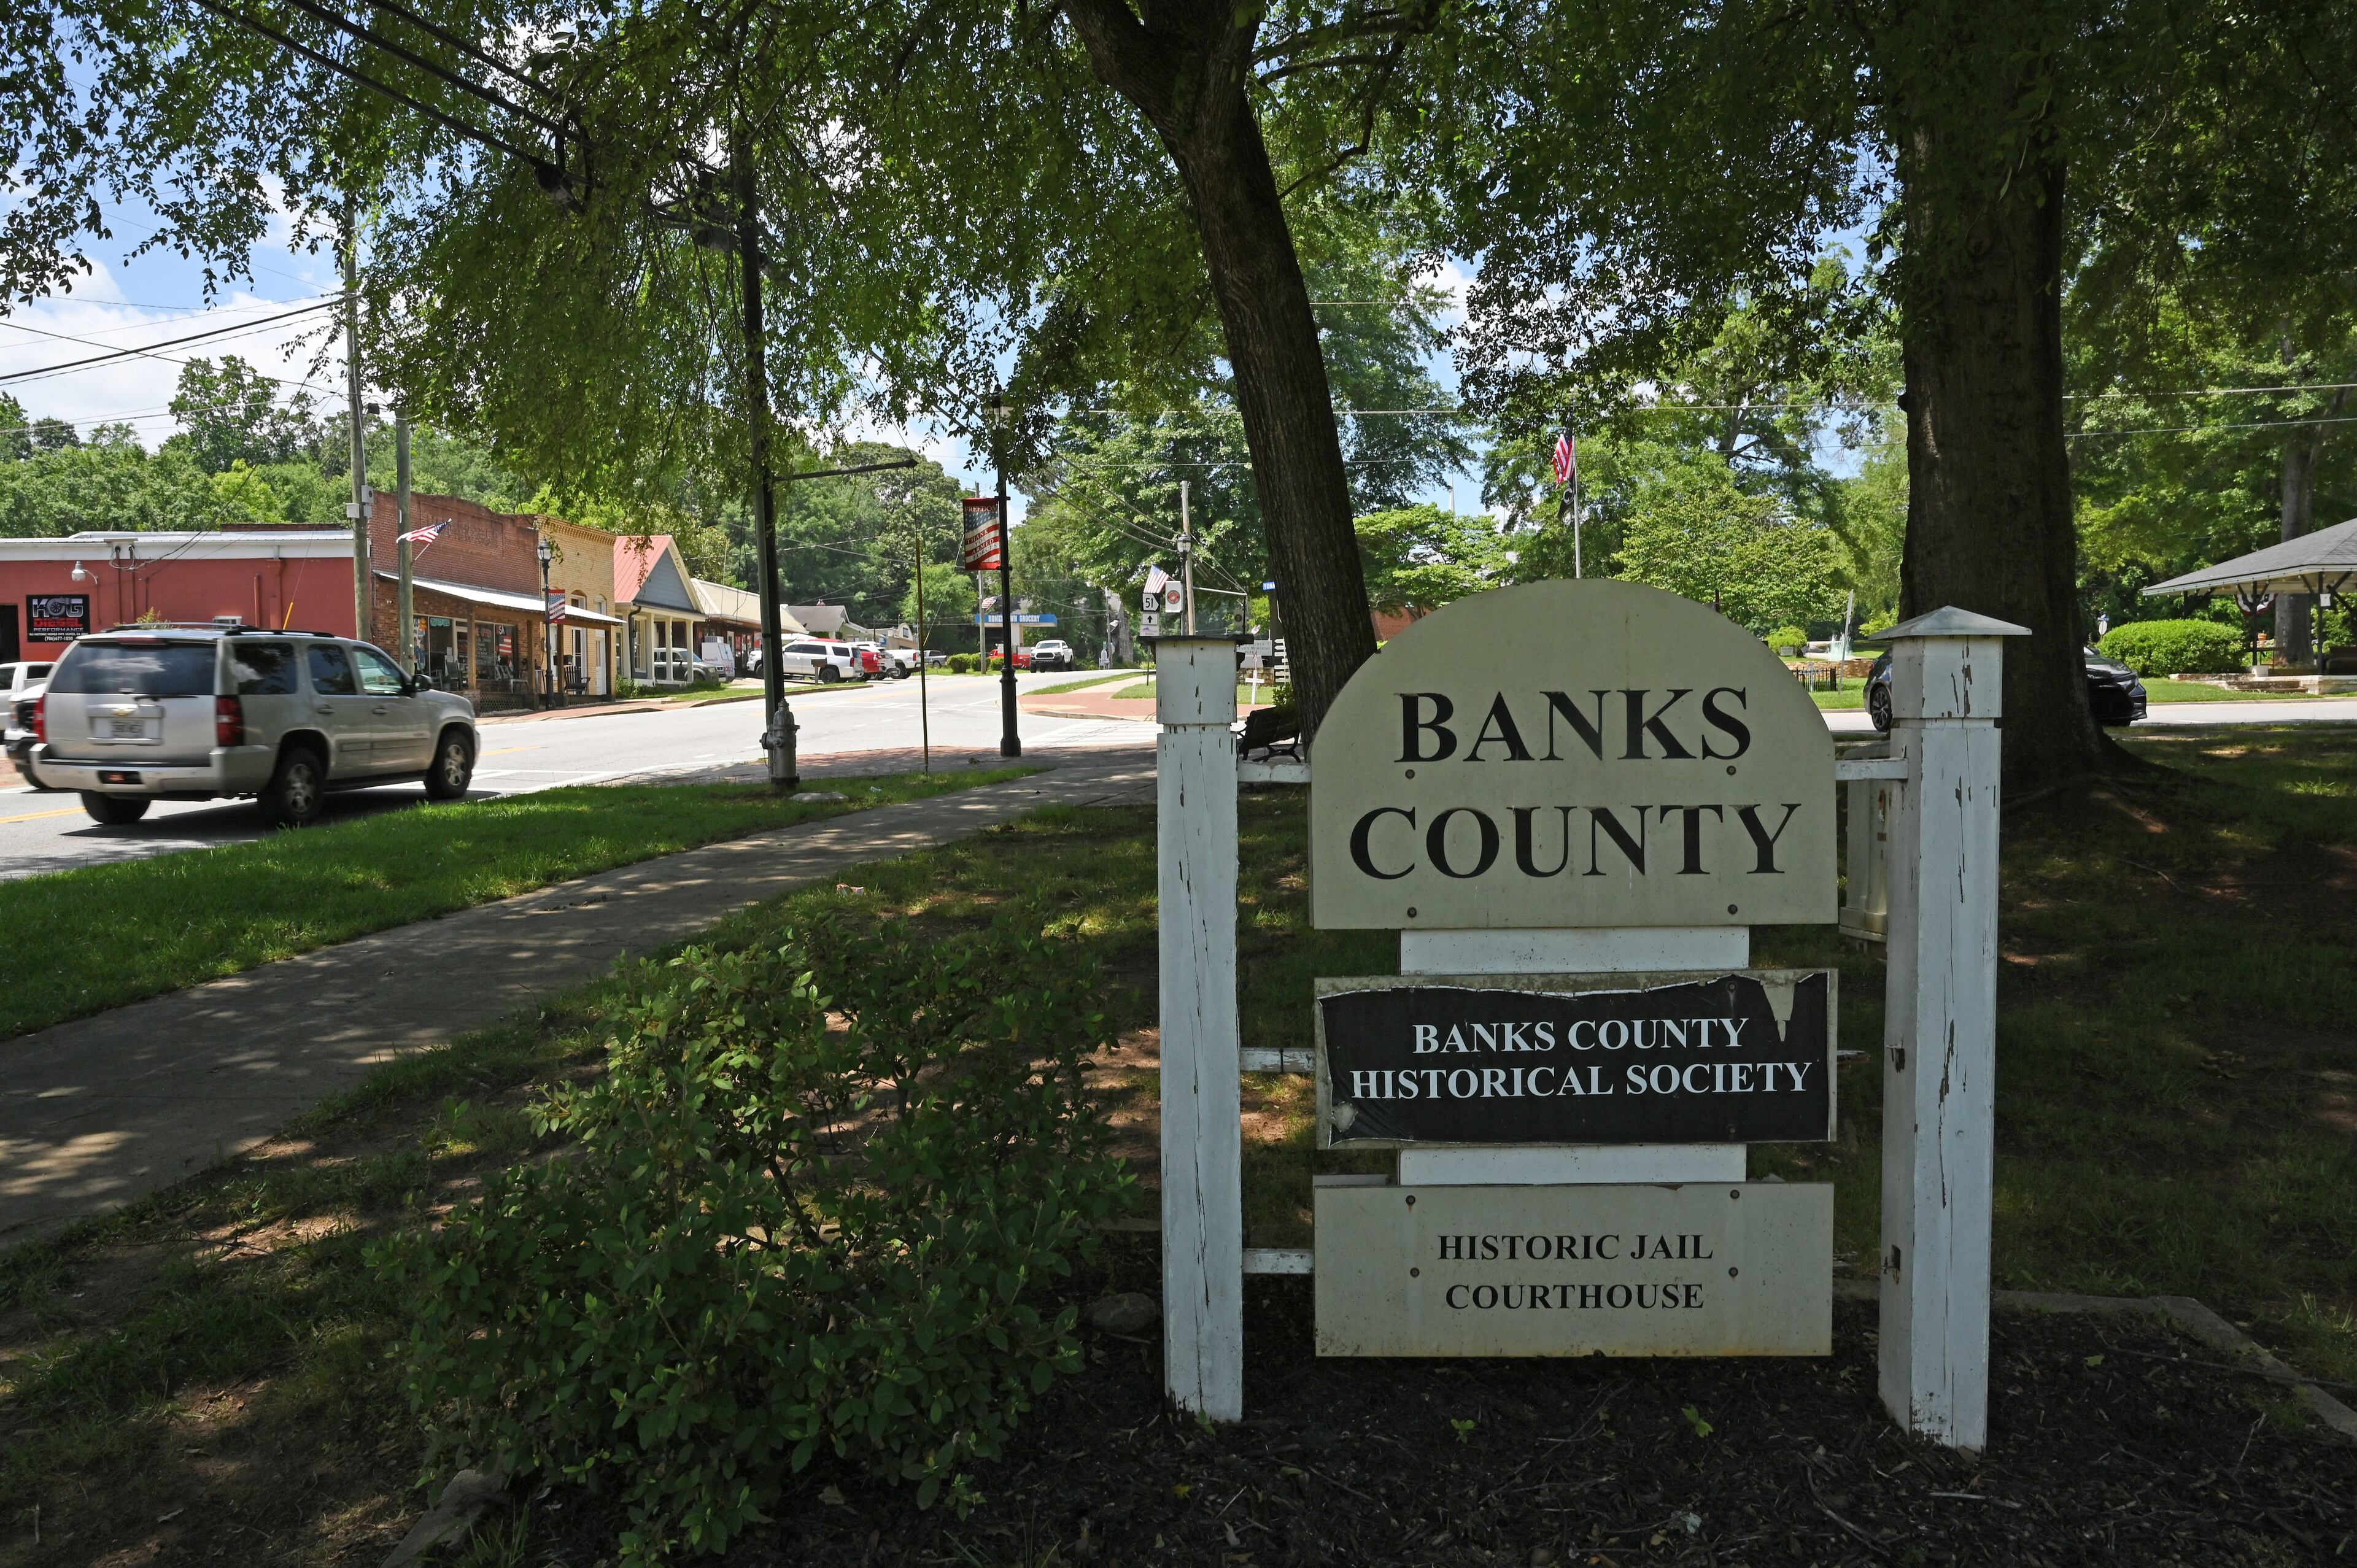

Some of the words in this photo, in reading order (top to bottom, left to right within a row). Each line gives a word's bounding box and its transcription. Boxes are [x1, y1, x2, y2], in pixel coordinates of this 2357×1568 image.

[967, 528, 989, 544] THANK
[972, 538, 994, 555] ARMED
[975, 535, 988, 546] YOU
[972, 544, 997, 560] FORCES
[1145, 598, 1153, 608] 51
[1394, 687, 1751, 763] BANKS
[1350, 803, 1802, 880] COUNTY
[1412, 1021, 1557, 1054] BANKS
[1568, 1017, 1749, 1052] COUNTY
[1350, 1065, 1614, 1100] HISTORICAL
[1626, 1061, 1813, 1096] SOCIETY
[1438, 1234, 1619, 1261] HISTORIC
[1630, 1233, 1714, 1260] JAIL
[1445, 1283, 1704, 1310] COURTHOUSE
